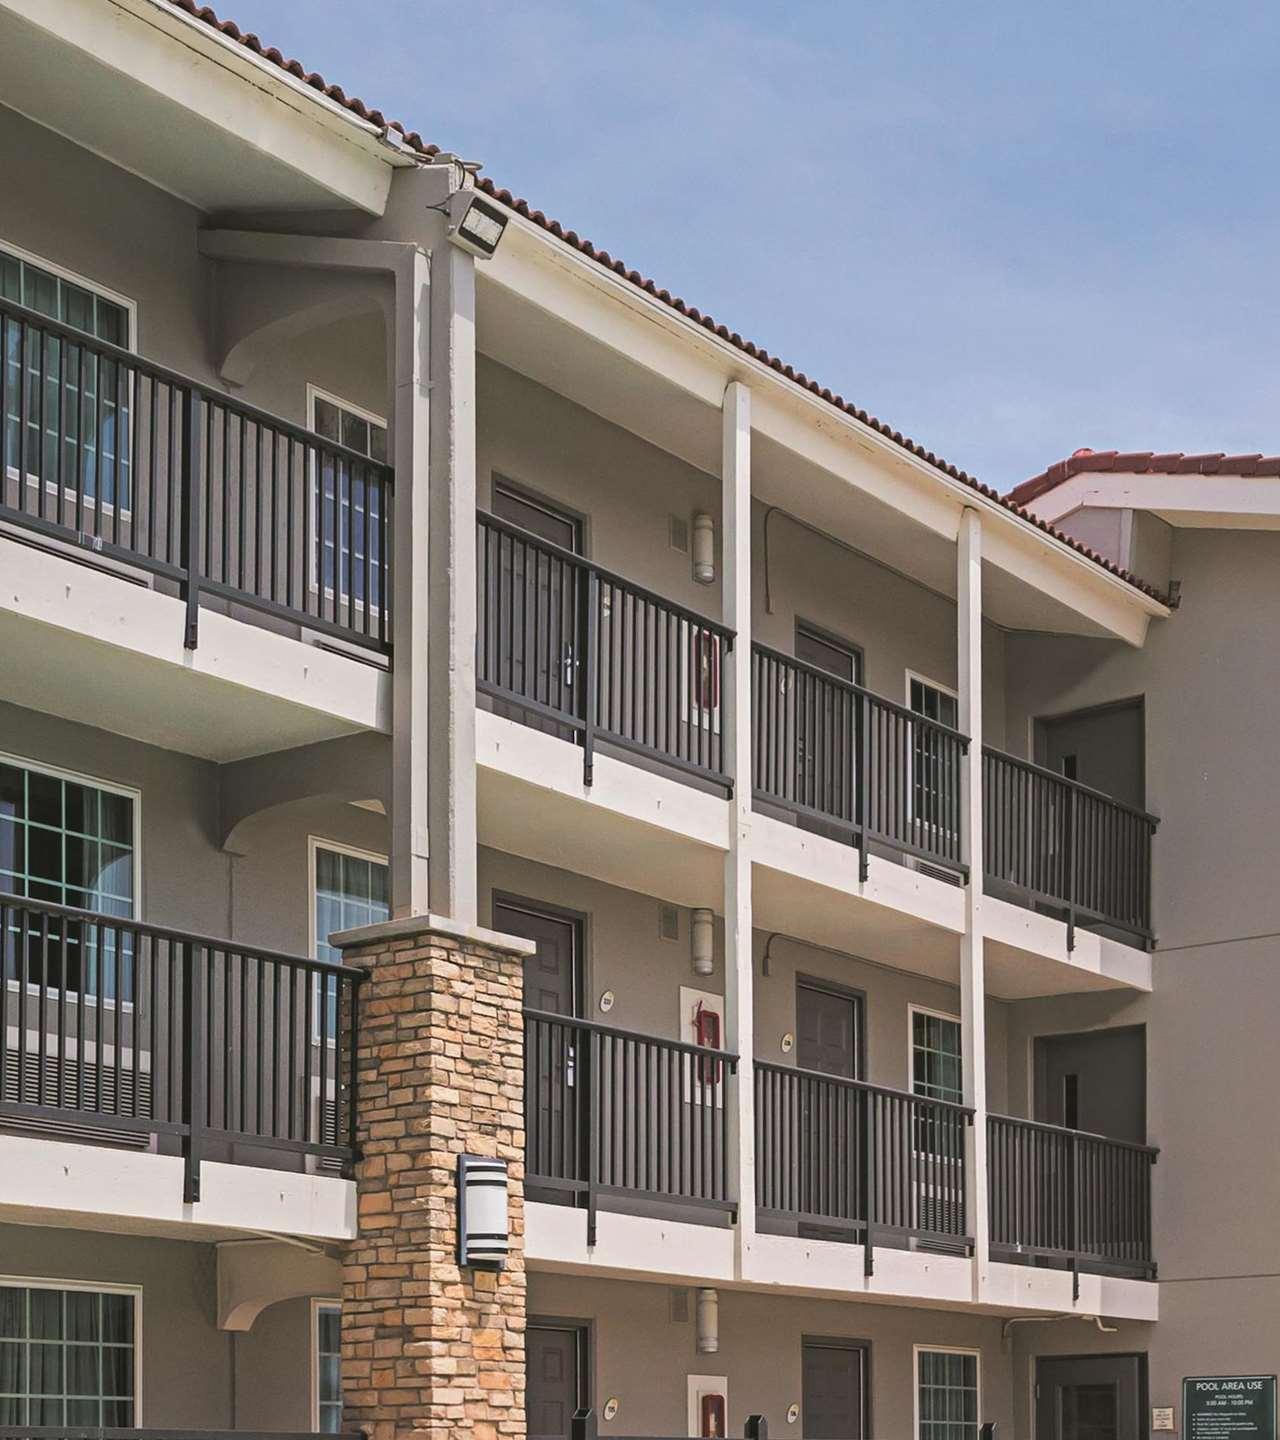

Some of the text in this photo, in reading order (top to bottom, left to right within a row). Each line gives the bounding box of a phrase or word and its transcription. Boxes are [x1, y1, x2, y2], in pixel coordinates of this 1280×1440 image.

[1195, 1381, 1264, 1391] POOL AREA USE
